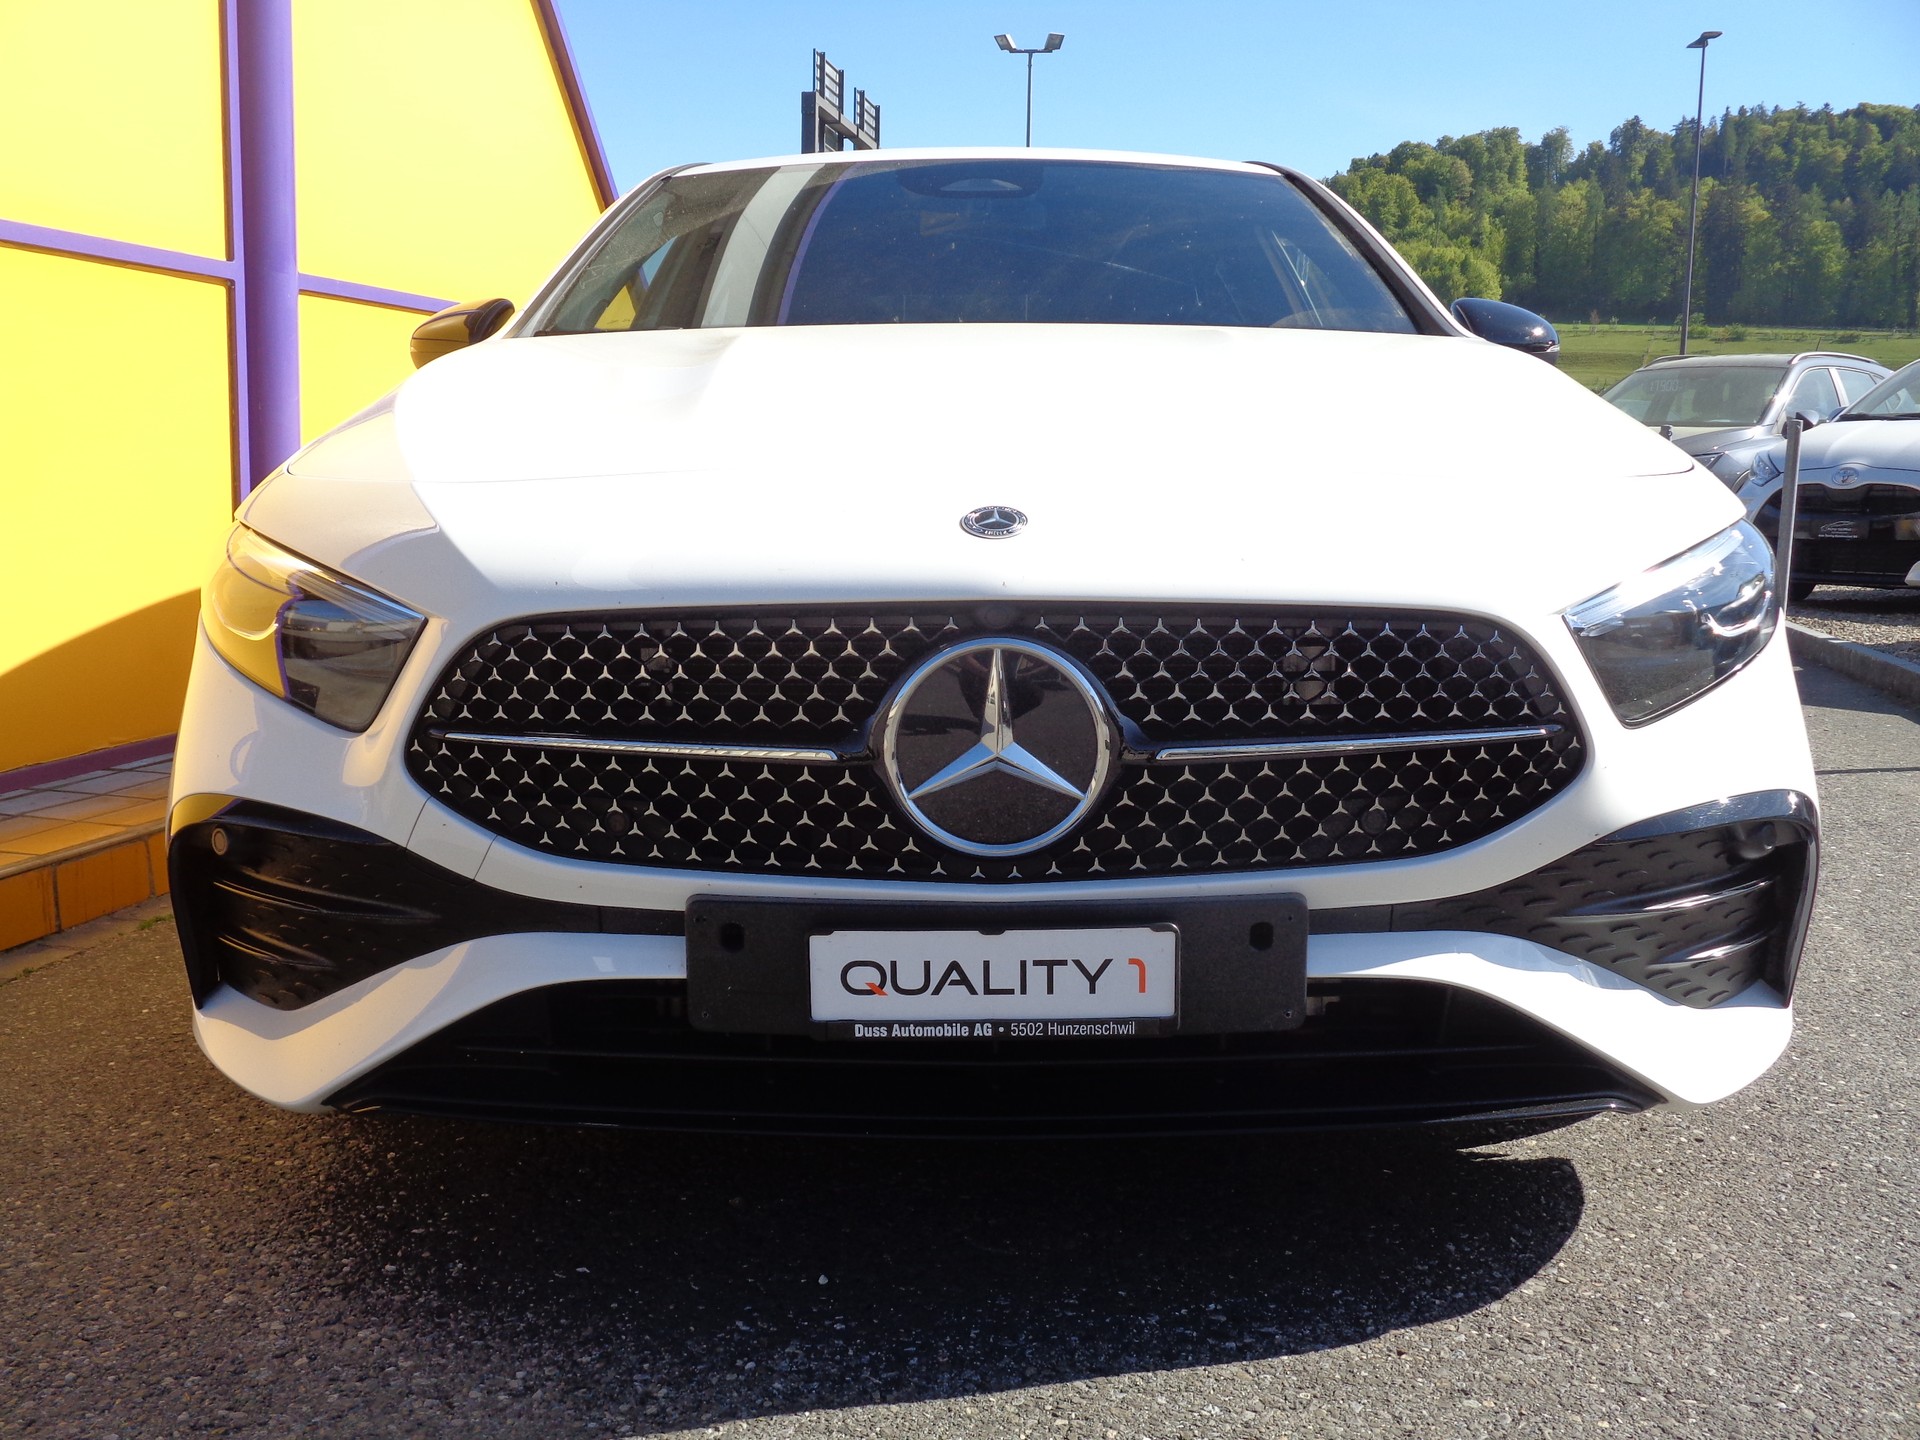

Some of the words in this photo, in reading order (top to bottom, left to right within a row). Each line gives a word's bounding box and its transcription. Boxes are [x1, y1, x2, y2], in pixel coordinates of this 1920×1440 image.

[840, 958, 1114, 996] QUALITY
[1127, 957, 1146, 994] 1
[854, 1023, 888, 1038] Duss
[891, 1023, 970, 1038] Automobile
[973, 1022, 993, 1037] AG
[1010, 1022, 1044, 1037] 5502
[1047, 1020, 1136, 1037] Hunzenschwil
